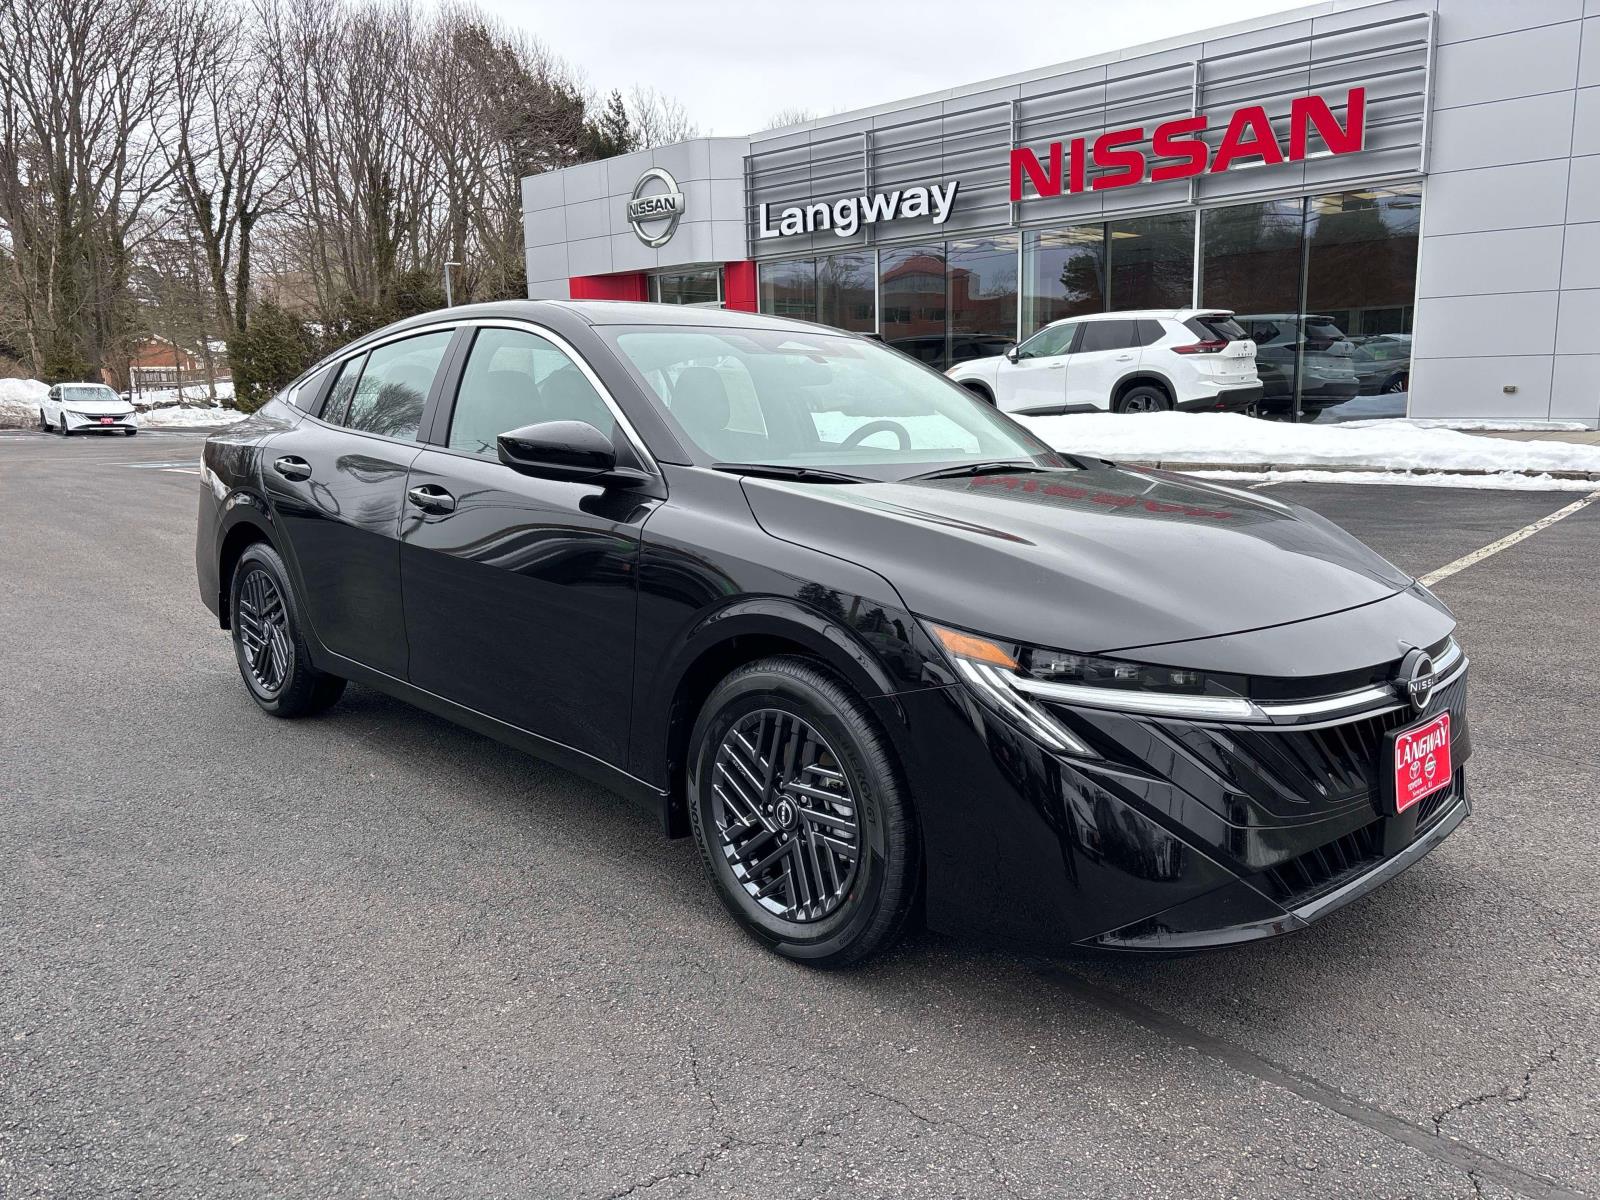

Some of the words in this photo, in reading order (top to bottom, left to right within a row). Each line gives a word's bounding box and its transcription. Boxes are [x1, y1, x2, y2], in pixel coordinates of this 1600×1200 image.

[758, 181, 959, 239] Langway
[1010, 87, 1365, 201] NISSAN
[629, 197, 676, 216] NISSAN
[1410, 678, 1434, 692] NISS
[1397, 725, 1448, 769] LANGWAY
